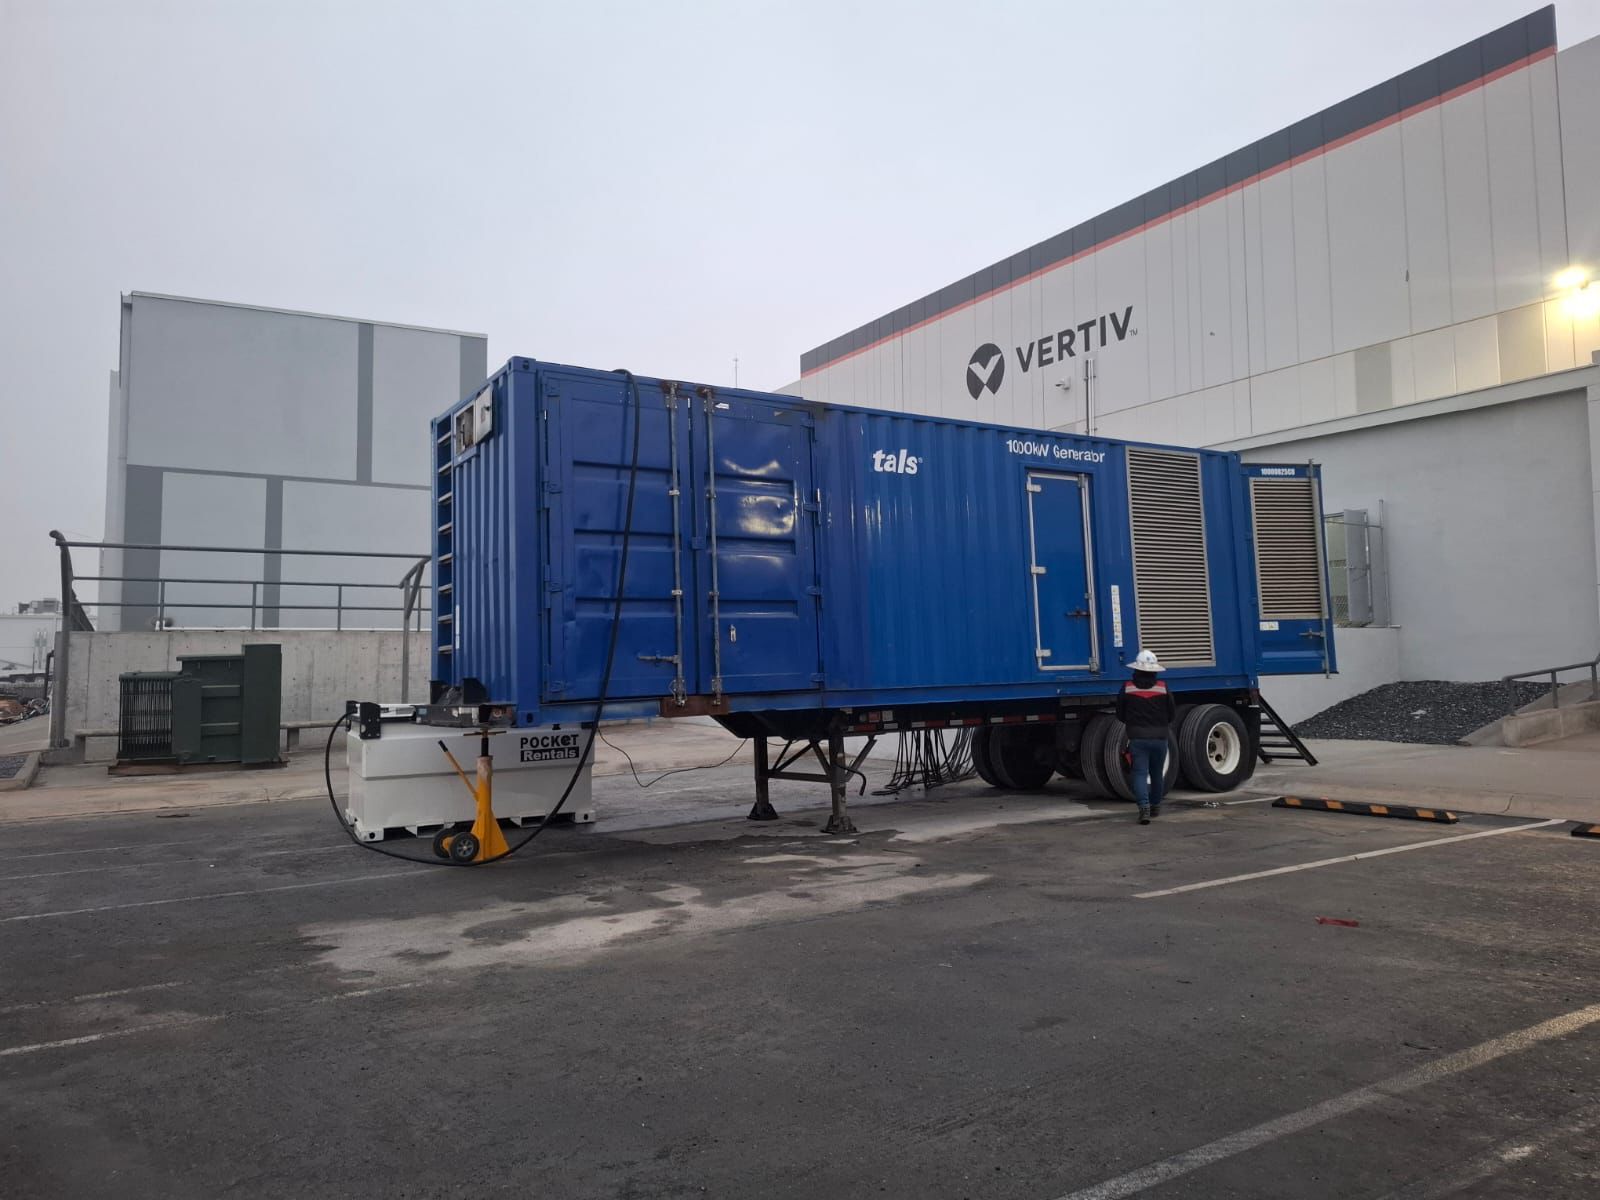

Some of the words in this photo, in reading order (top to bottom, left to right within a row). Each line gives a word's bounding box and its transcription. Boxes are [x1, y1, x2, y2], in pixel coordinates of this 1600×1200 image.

[1015, 305, 1133, 373] VERTIV
[872, 448, 918, 475] tals
[523, 747, 577, 761] Rentals
